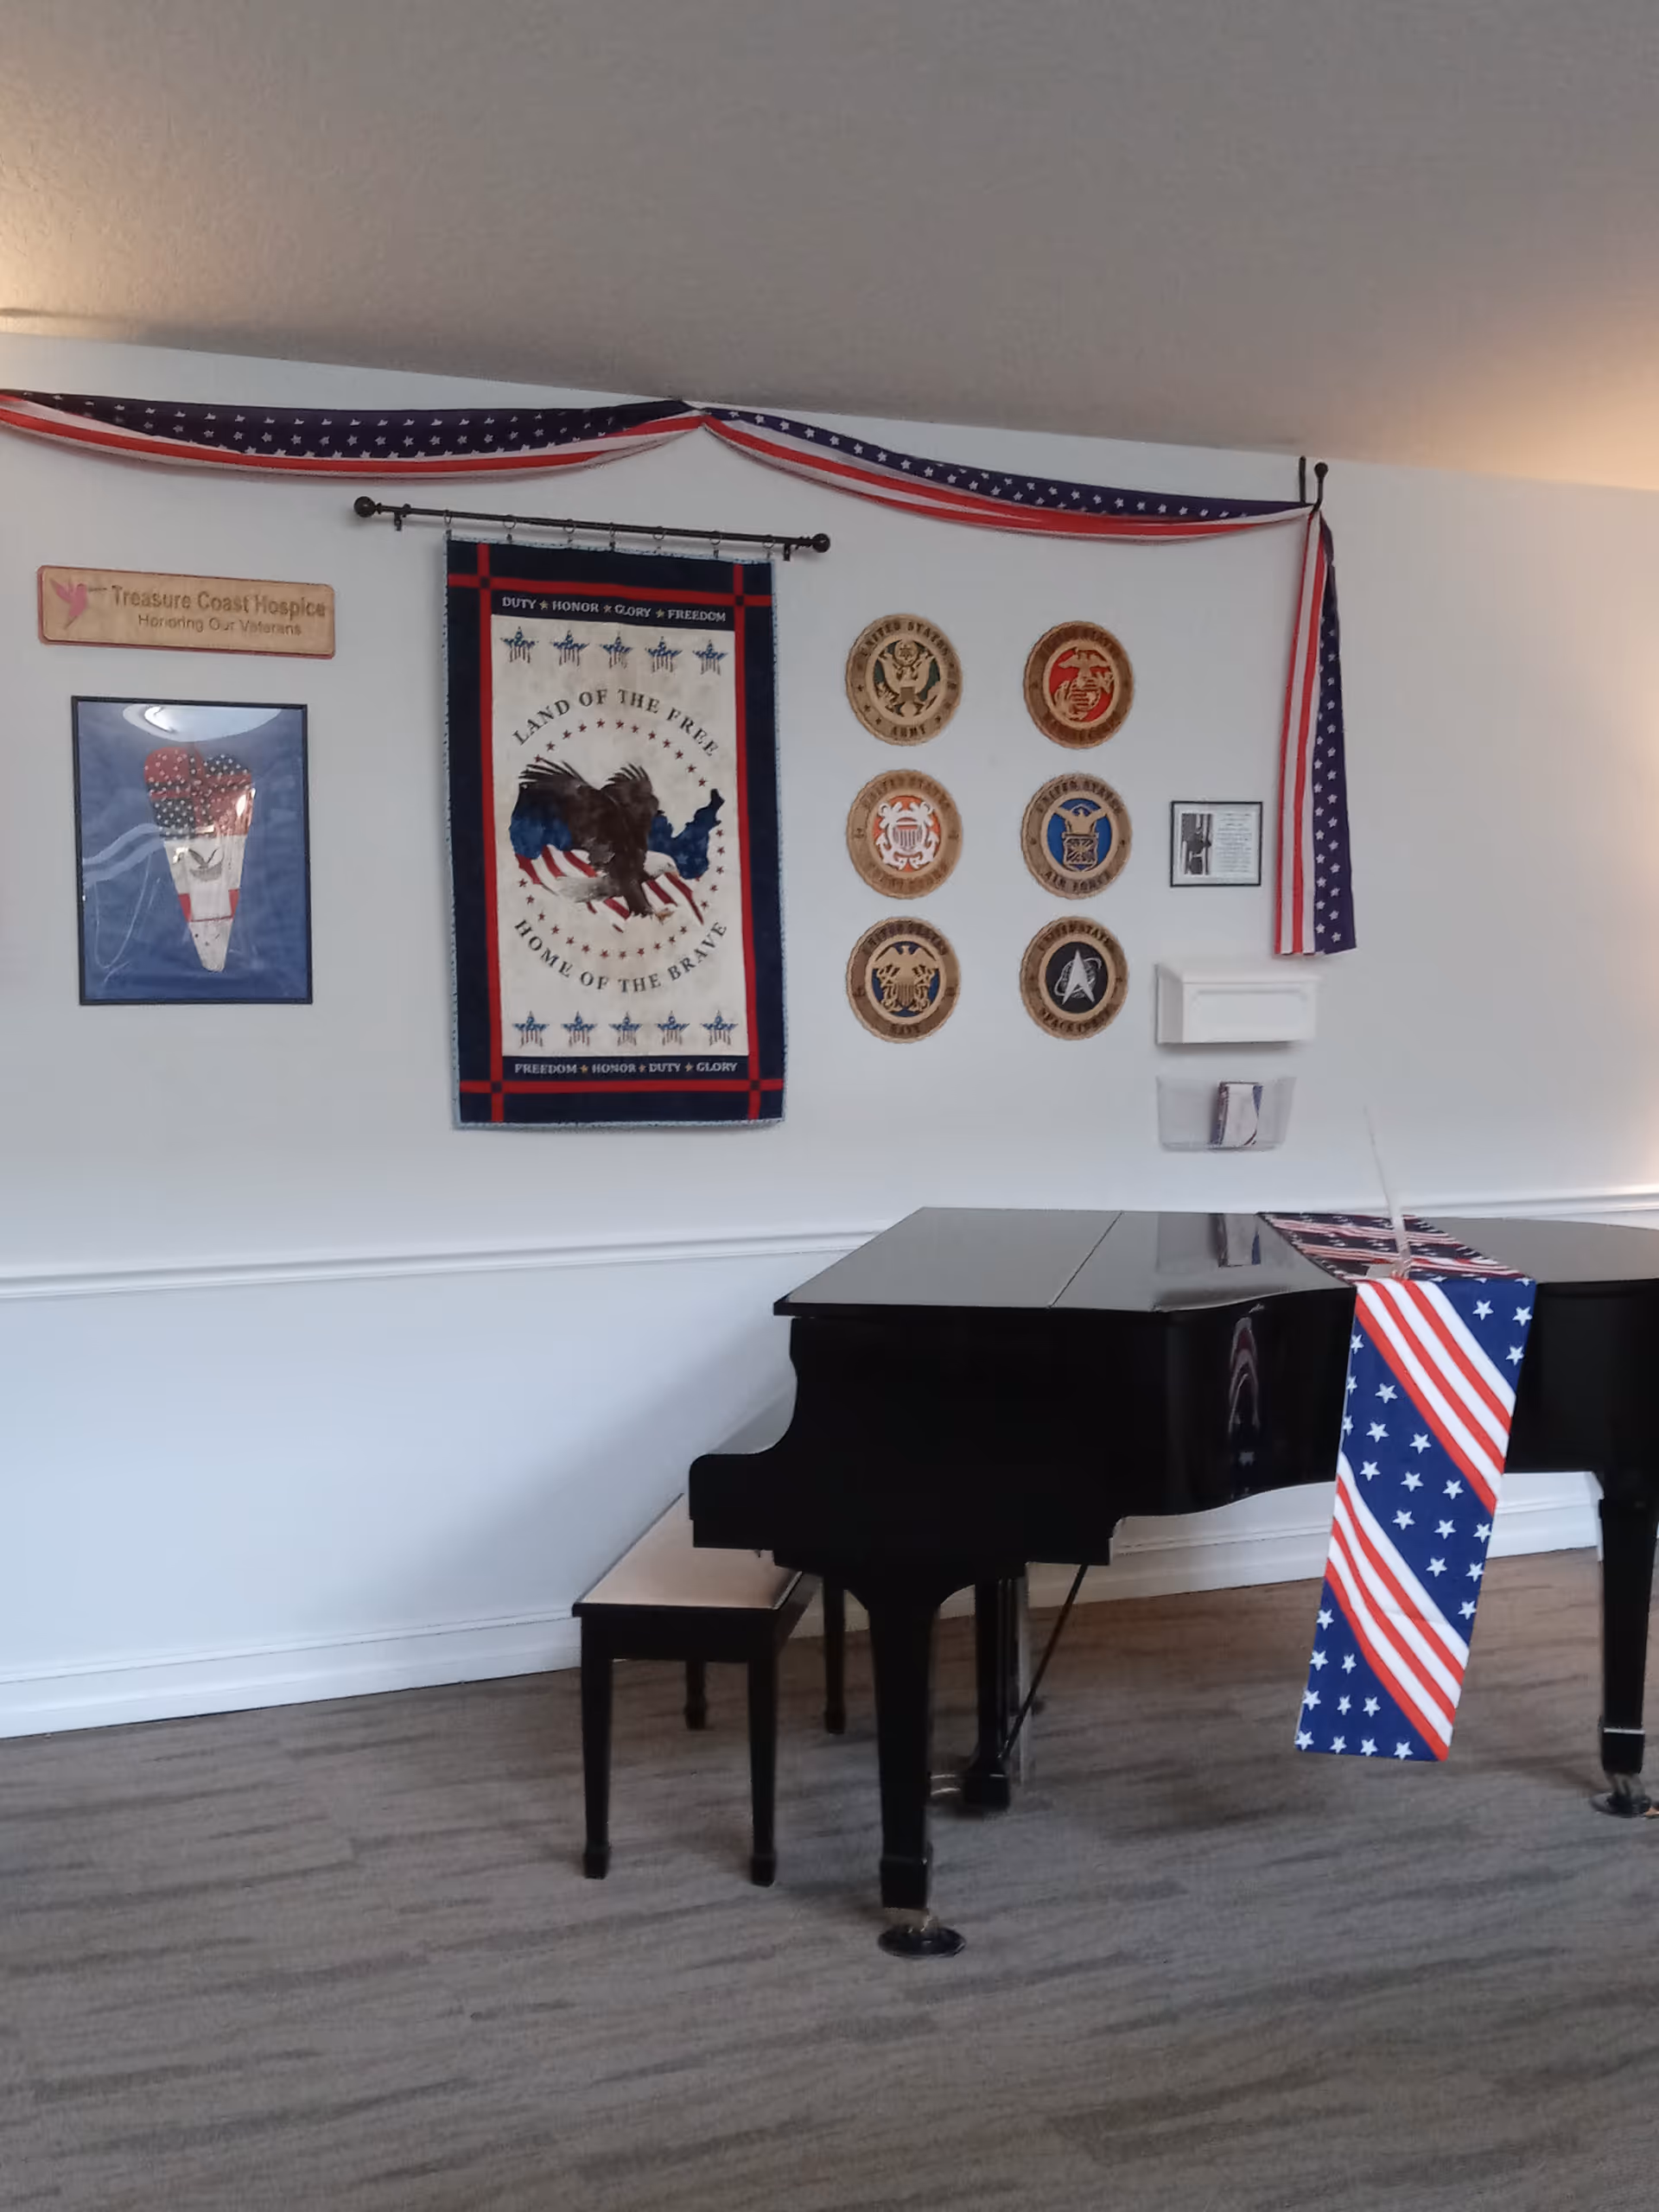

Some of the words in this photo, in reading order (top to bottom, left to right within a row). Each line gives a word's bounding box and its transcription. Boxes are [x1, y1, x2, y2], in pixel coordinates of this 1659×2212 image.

[111, 584, 191, 609] Treasure
[197, 590, 250, 613] Coast
[255, 594, 326, 620] Hospice
[501, 596, 537, 609] DUTY
[552, 600, 600, 613] HONOR
[614, 604, 652, 618] GLORY
[667, 608, 727, 622] FREEDOM
[138, 613, 204, 633] Honoring
[209, 617, 234, 632] Our
[241, 619, 302, 637] Veterans
[512, 699, 571, 747] LAND
[579, 689, 608, 708] OF
[617, 689, 661, 715] THE
[666, 707, 720, 758] FREE
[514, 918, 574, 979] HOME
[580, 970, 609, 990] OF
[618, 973, 662, 994] THE
[667, 921, 728, 982] BRAVE
[514, 1064, 577, 1074] FREEDOM
[591, 1064, 637, 1074] HONOR
[649, 1062, 681, 1072] DUTY
[696, 1062, 738, 1072] GLORY
